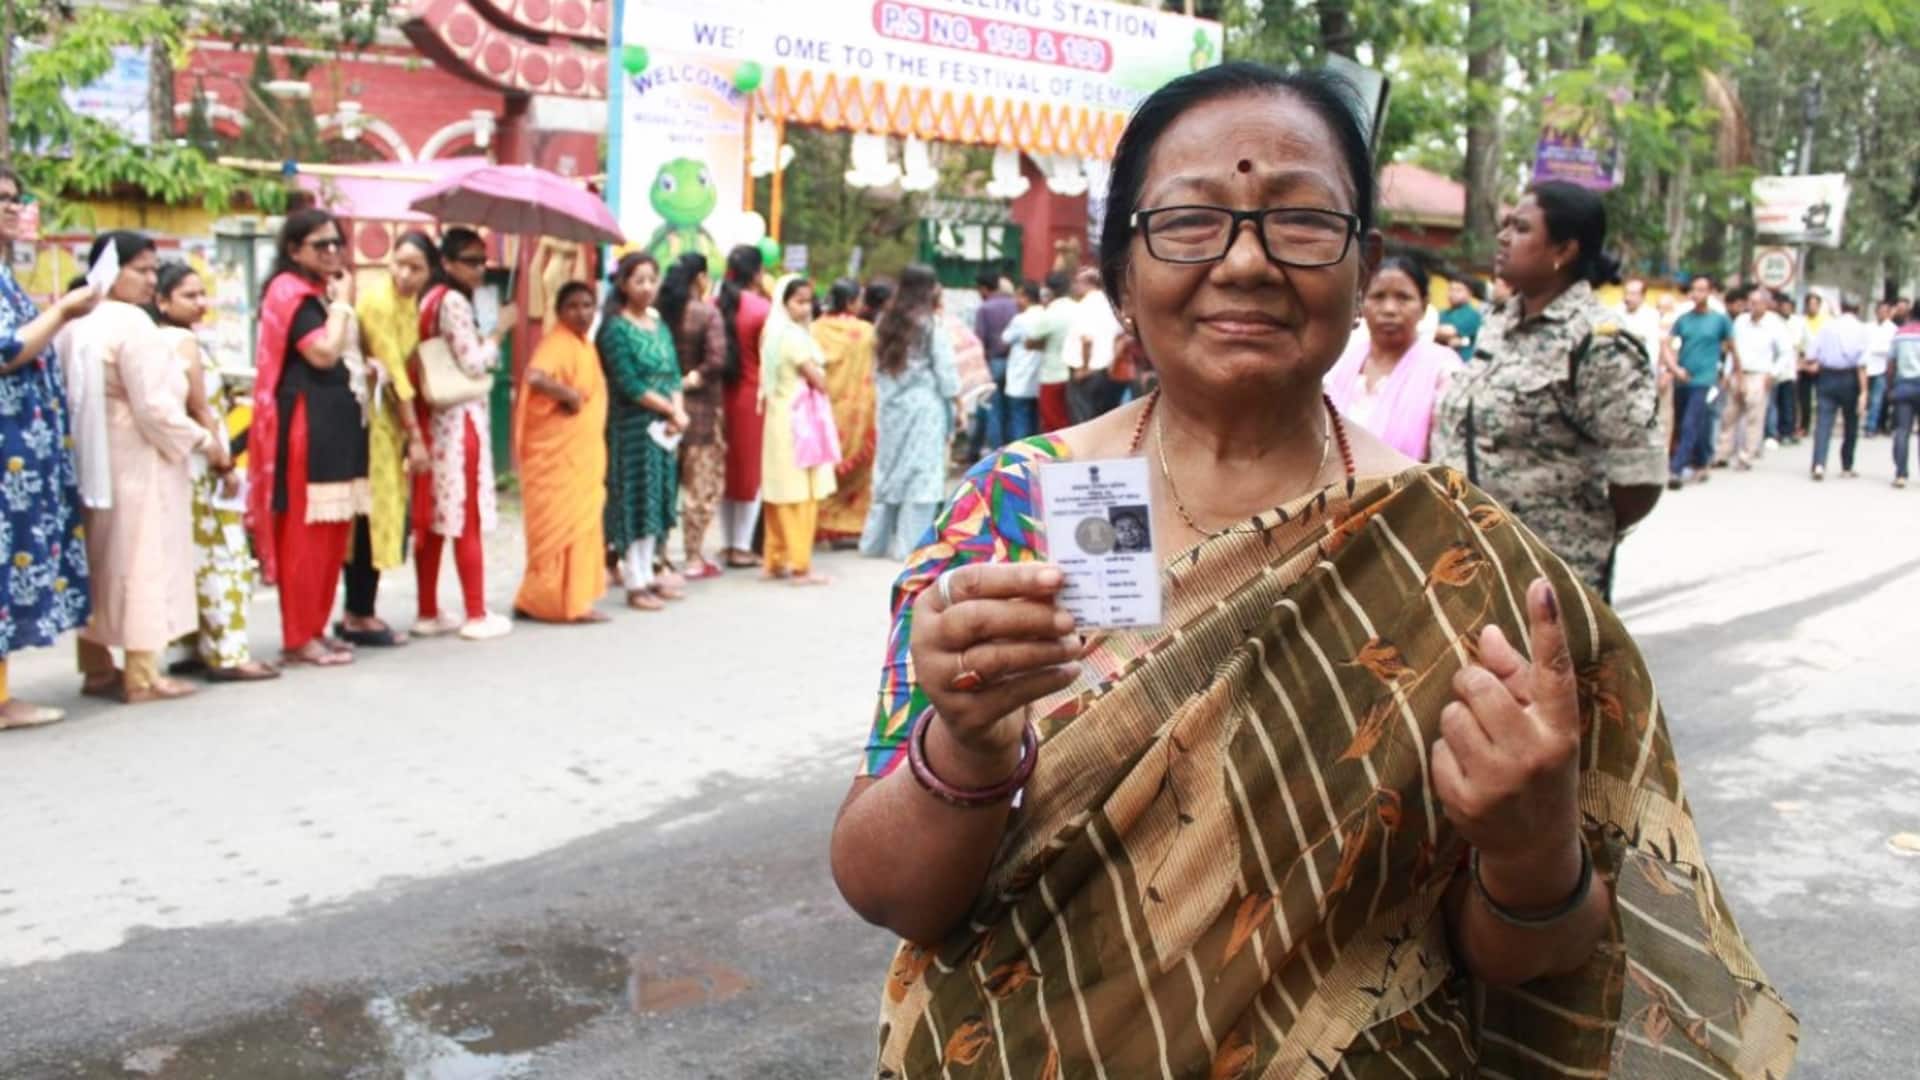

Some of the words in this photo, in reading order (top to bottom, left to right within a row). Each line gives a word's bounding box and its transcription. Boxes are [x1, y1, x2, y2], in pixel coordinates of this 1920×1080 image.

[1053, 0, 1157, 39] STATION
[1039, 36, 1053, 57] &
[842, 44, 873, 69] TO
[885, 51, 928, 77] THE
[939, 60, 1041, 94] FESTIVAL
[1049, 76, 1073, 97] OF
